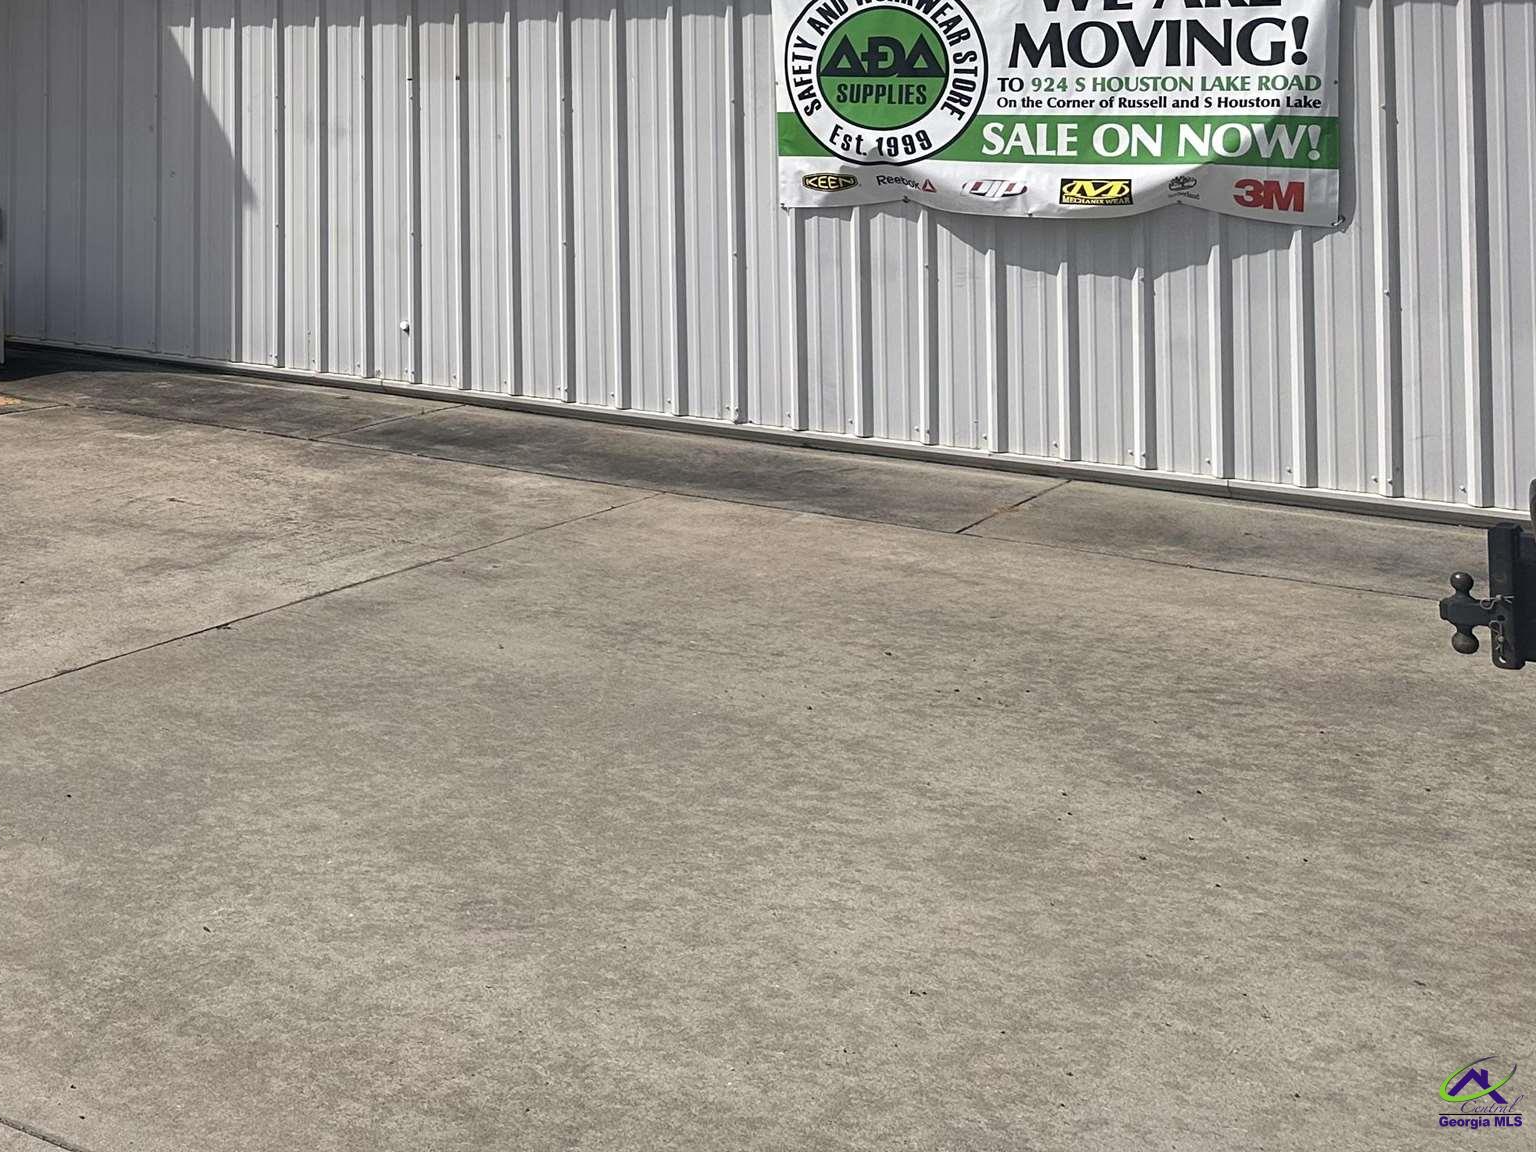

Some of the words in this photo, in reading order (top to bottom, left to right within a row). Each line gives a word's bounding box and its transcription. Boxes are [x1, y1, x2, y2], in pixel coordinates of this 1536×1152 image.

[820, 33, 946, 77] ADA
[1008, 15, 1309, 69] MOVING!
[792, 35, 822, 117] SAFETY
[940, 50, 978, 121] STORE
[837, 83, 927, 105] SUPPLIES
[997, 77, 1024, 92] TO
[1031, 77, 1068, 92] 924
[1075, 77, 1086, 92] S
[1093, 76, 1193, 92] HOUSTON
[1201, 76, 1251, 91] LAKE
[1258, 75, 1322, 91] ROAD
[997, 97, 1017, 108] On
[1022, 96, 1043, 108] the
[1047, 97, 1095, 108] Corner
[1100, 96, 1115, 108] of
[1119, 96, 1167, 108] Russell
[1172, 96, 1199, 108] and
[1204, 96, 1212, 108] S
[1217, 97, 1280, 108] Houston
[1286, 96, 1321, 109] Lake
[828, 124, 867, 156] Est.
[876, 129, 932, 157] 1999
[981, 122, 1078, 157] SALE
[1092, 123, 1162, 157] ON
[1178, 123, 1321, 161] NOW!
[806, 175, 855, 189] KEEN
[876, 175, 922, 190] Reebok
[1233, 179, 1305, 212] 3M
